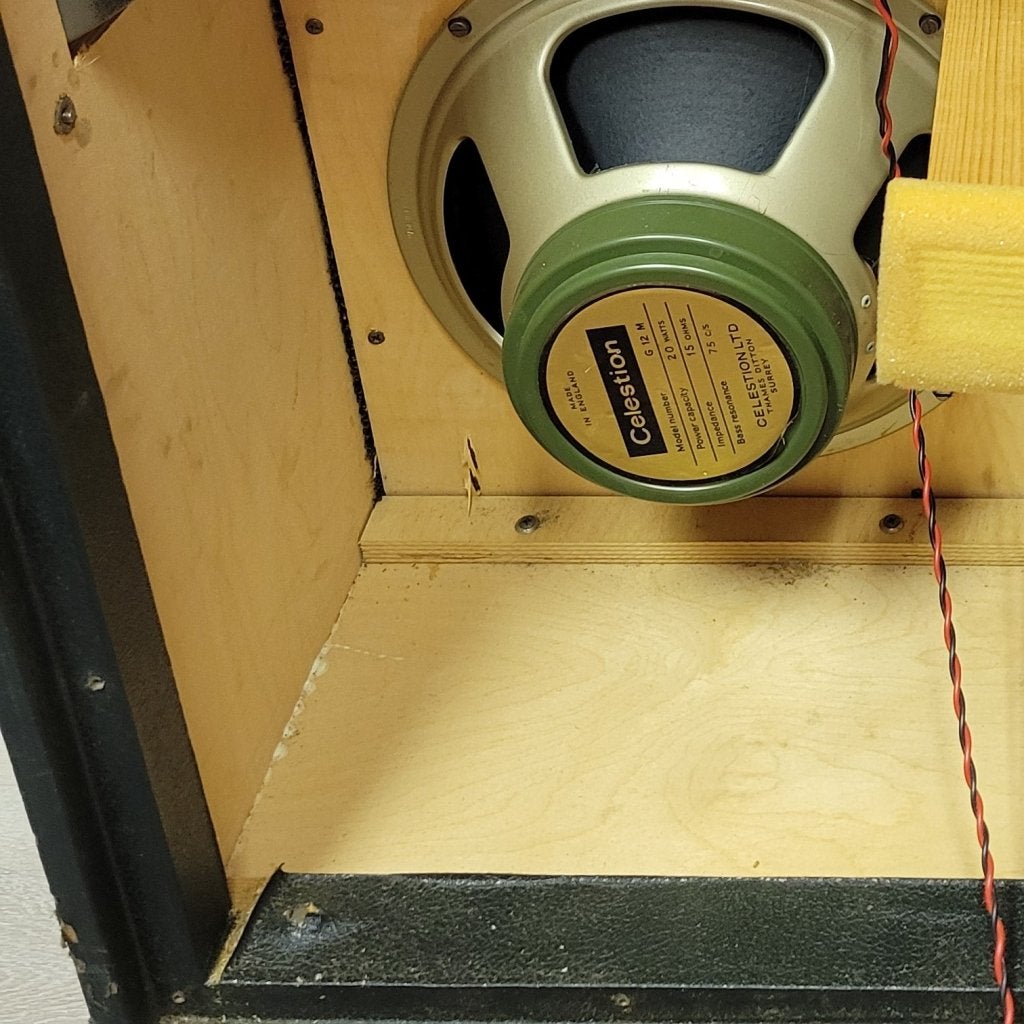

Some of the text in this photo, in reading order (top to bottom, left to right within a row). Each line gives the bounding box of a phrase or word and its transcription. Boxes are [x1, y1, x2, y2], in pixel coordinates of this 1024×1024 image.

[636, 323, 644, 331] M
[640, 335, 649, 346] 12
[658, 320, 677, 361] 20 WATTS
[679, 318, 695, 356] 15 OHMS
[707, 341, 718, 355] 75
[605, 339, 651, 445] Celestion
[728, 323, 768, 427] CELESTION LTD
[746, 339, 774, 414] THAMES DITTON
[762, 358, 778, 393] SURREY
[565, 388, 577, 409] MADE
[567, 370, 592, 426] IN ENGLAND
[680, 388, 705, 450] Power capacity
[721, 380, 746, 444] Bass resonance
[661, 393, 685, 452] Model number
[706, 402, 725, 447] Impedance
